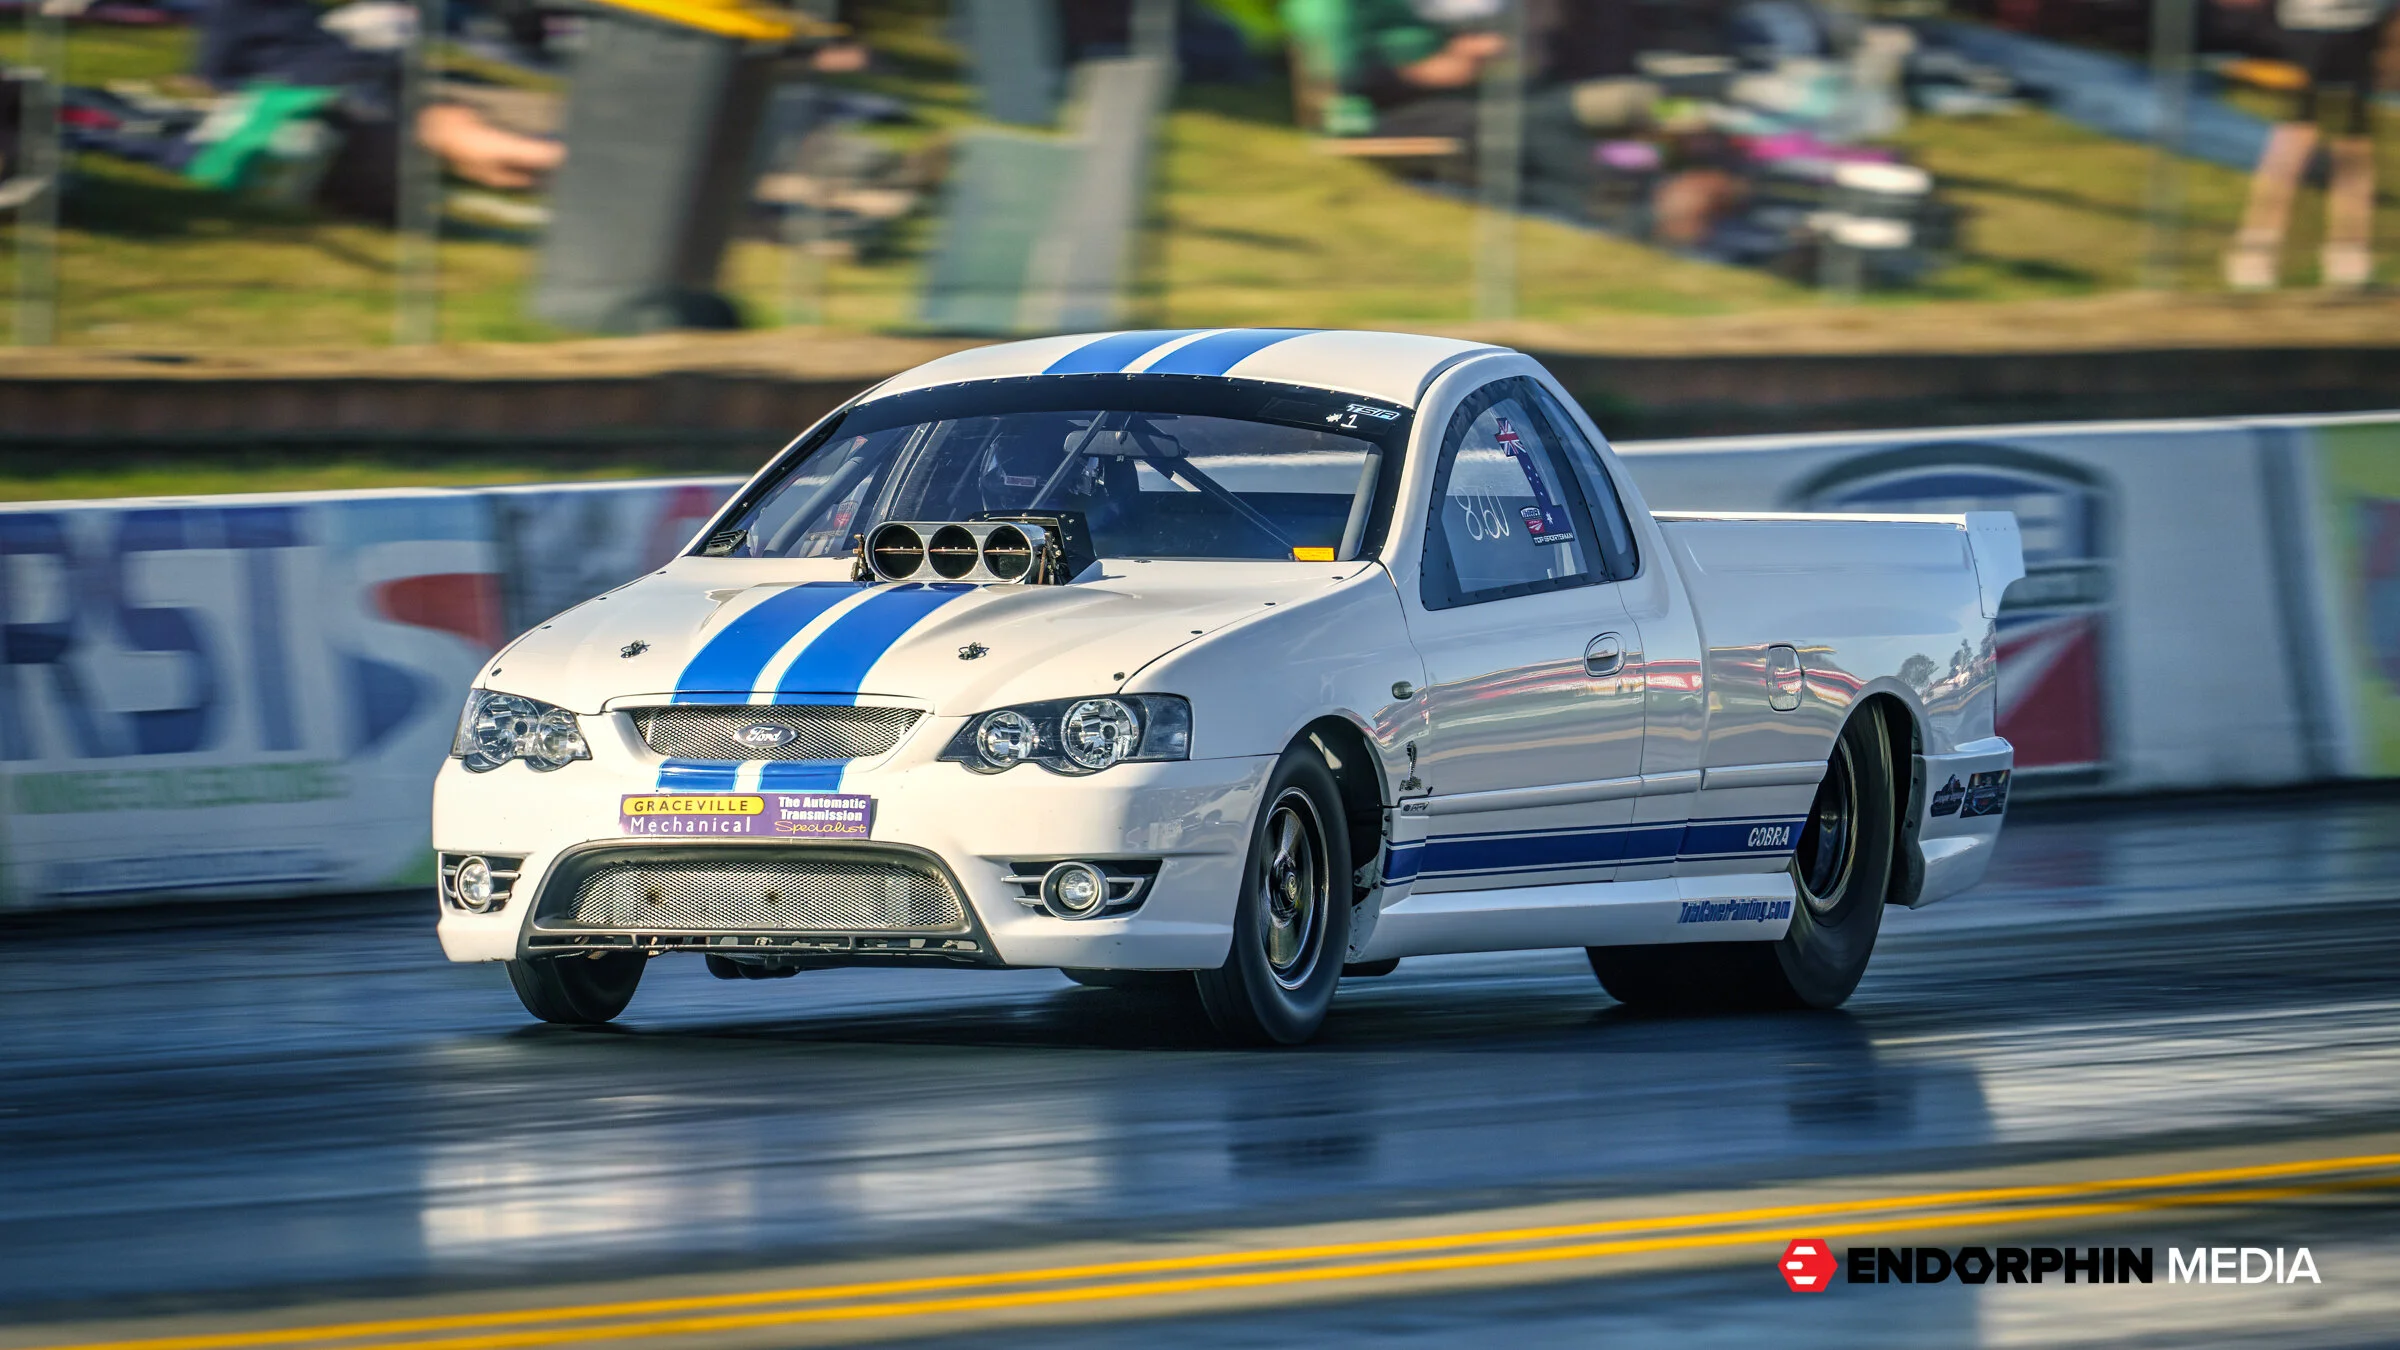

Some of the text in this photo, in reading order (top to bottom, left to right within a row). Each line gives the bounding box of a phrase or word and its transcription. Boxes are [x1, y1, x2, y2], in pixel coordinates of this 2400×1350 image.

[746, 726, 781, 743] Ford
[633, 800, 749, 812] GRACEVILLE
[778, 796, 867, 810] The Automatic
[780, 809, 863, 821] Transmission
[630, 816, 751, 834] Mechanical
[774, 820, 867, 835] Specialist
[1747, 826, 1791, 847] COBRA
